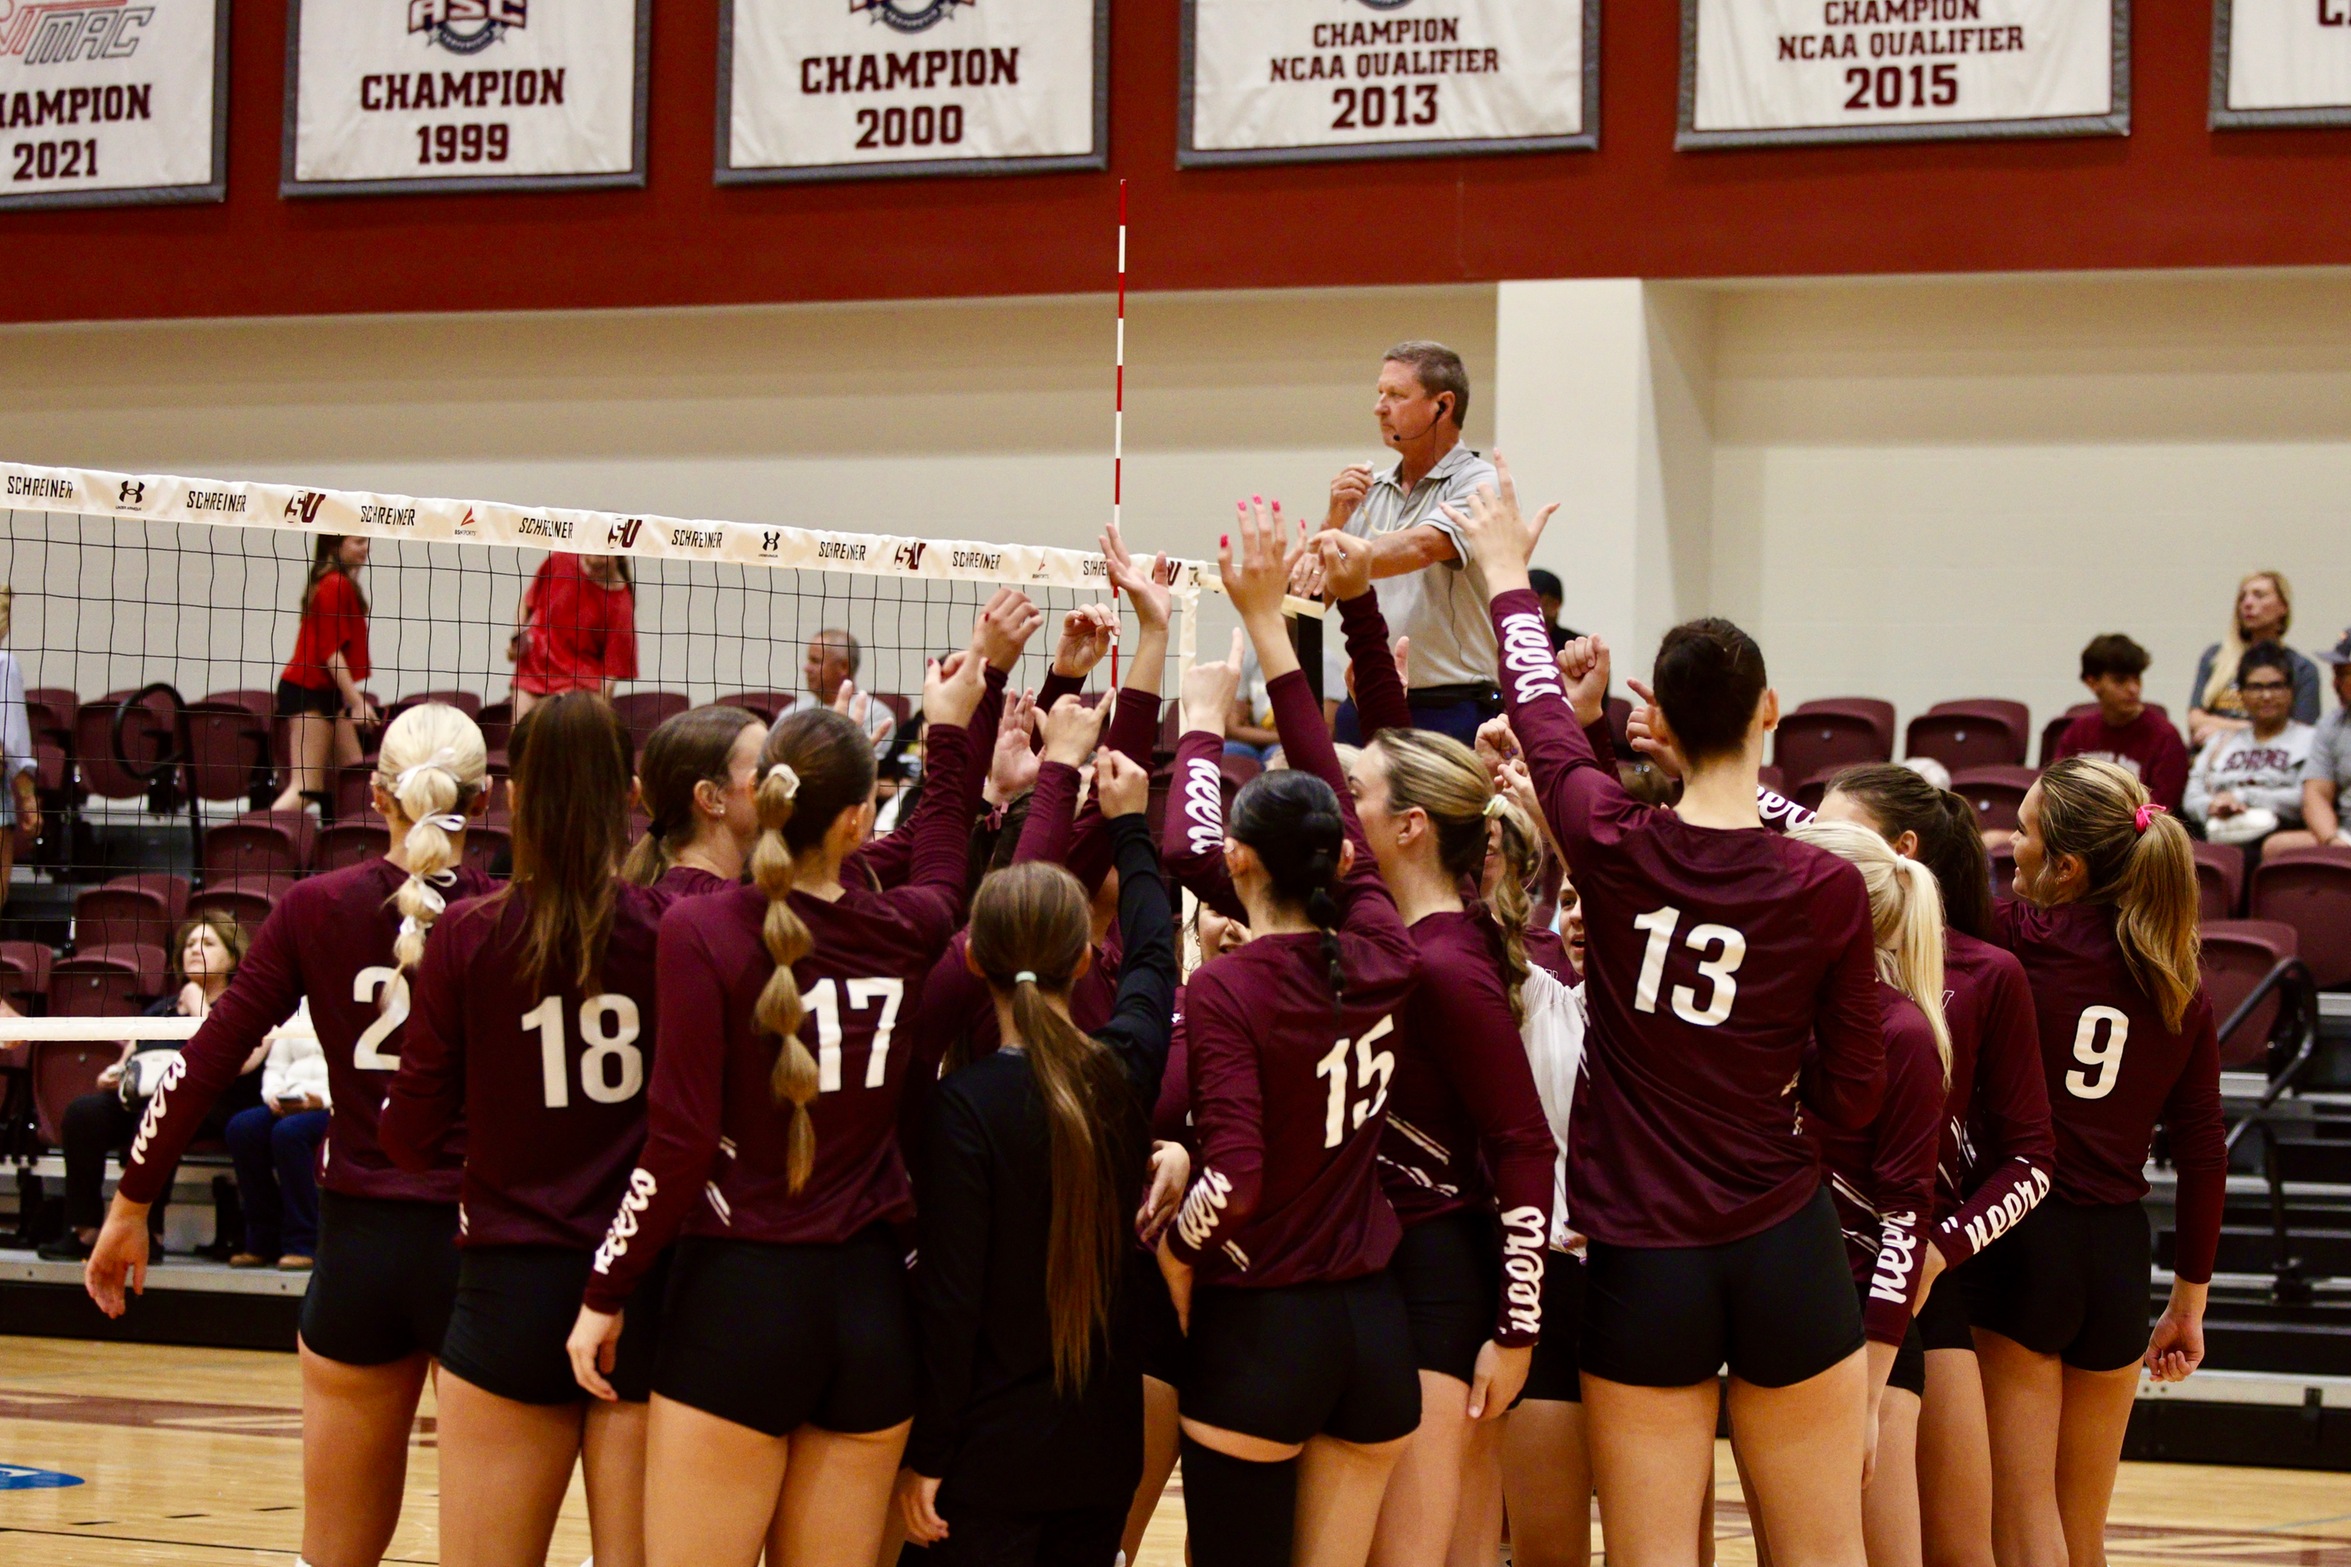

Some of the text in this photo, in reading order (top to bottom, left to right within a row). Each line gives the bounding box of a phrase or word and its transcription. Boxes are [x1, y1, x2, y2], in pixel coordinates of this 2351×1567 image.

[1313, 18, 1459, 49] CHAMPION
[1823, 0, 1981, 26] CHAMPION
[1269, 47, 1499, 82] NCAA QUALIFIER
[1778, 26, 2025, 61] NCAA QUALIFIER
[360, 67, 566, 111] CHAMPION
[801, 47, 1019, 95] CHAMPION
[1844, 63, 1959, 110] 2015
[855, 105, 964, 149] 2000
[1331, 83, 1438, 129] 2013
[12, 138, 98, 182] 2021
[416, 123, 509, 165] 1999
[7, 475, 73, 499] SCHREINER
[186, 490, 247, 513] SCHREINER
[360, 505, 416, 526] SCHREINER
[518, 517, 574, 540] SCHREINER
[671, 529, 723, 549] SCHREINER
[818, 541, 867, 561] SCHREINER
[952, 551, 1001, 571] SCHREINER
[1633, 905, 1747, 1027] 13
[353, 965, 411, 1071] 2
[801, 976, 904, 1092] 17
[521, 994, 642, 1108] 18
[2065, 1005, 2129, 1100] 9
[1316, 1013, 1395, 1149] 15
